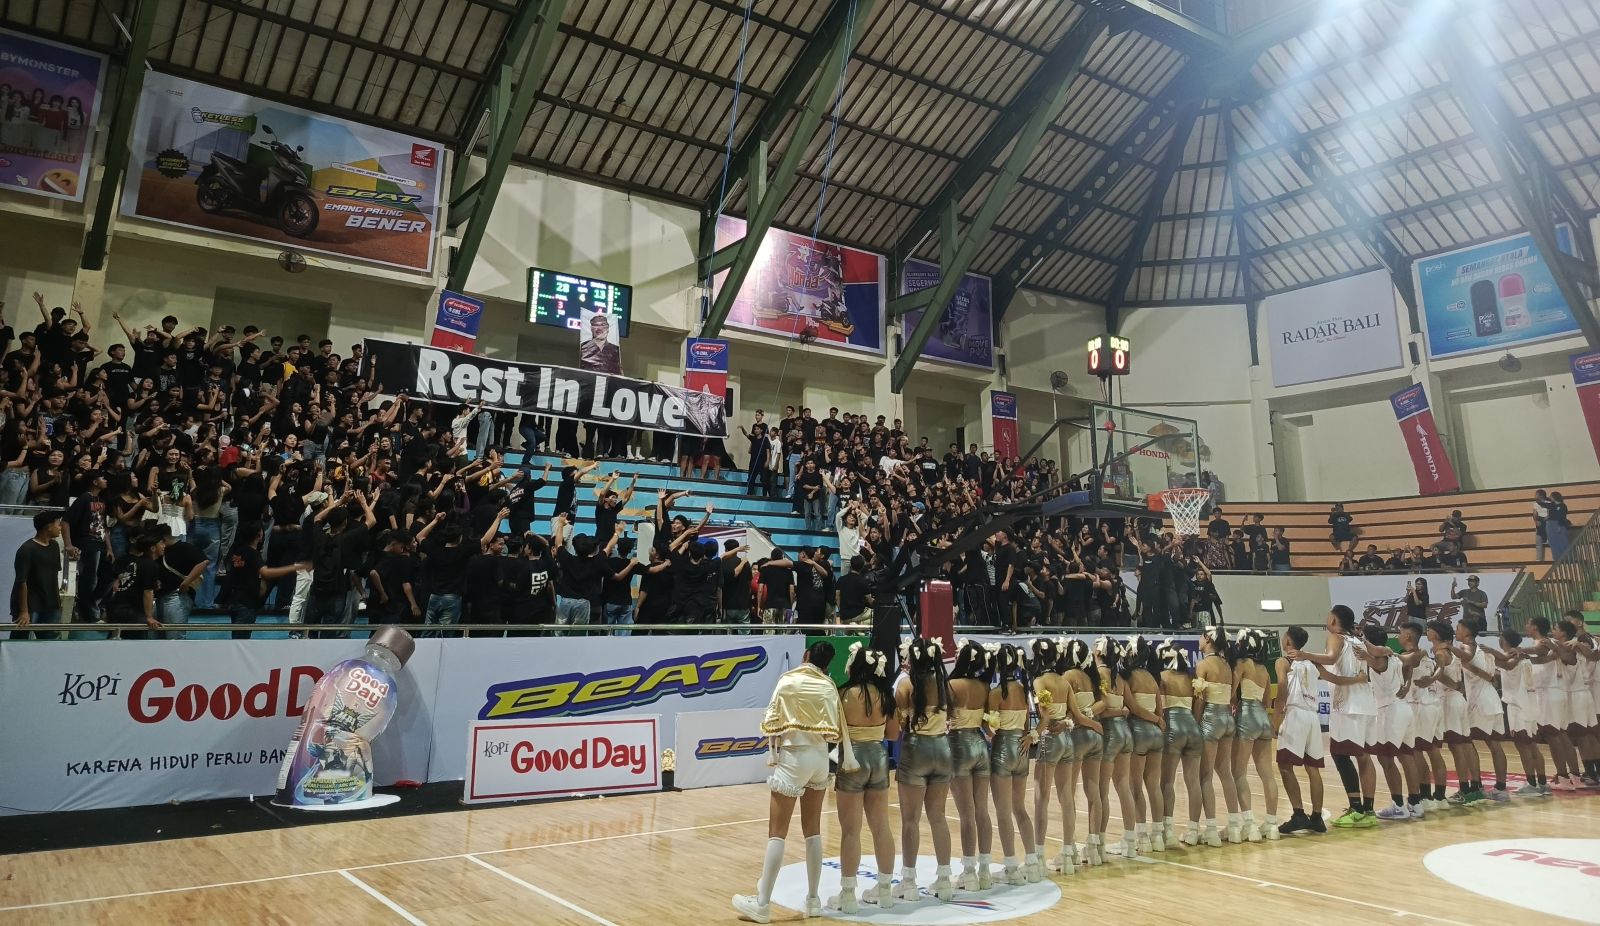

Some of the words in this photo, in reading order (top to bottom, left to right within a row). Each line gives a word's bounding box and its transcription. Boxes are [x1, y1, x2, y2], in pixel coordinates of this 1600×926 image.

[324, 203, 363, 213] EMANG
[364, 207, 404, 218] PALING
[345, 214, 426, 233] BENER
[1282, 322, 1339, 345] RADAR
[1343, 312, 1382, 333] BALI
[1091, 349, 1099, 369] 0
[1115, 349, 1125, 369] 0
[415, 346, 525, 405] Rest
[540, 367, 581, 414] In
[590, 377, 688, 428] Love
[1139, 449, 1170, 459] HONDA
[1419, 436, 1440, 482] HONDA
[345, 679, 382, 709] Day
[349, 667, 389, 698] Good
[66, 757, 142, 776] KARENA
[150, 752, 199, 771] HIDUP
[206, 751, 253, 768] PERLU
[259, 748, 288, 765] BAN
